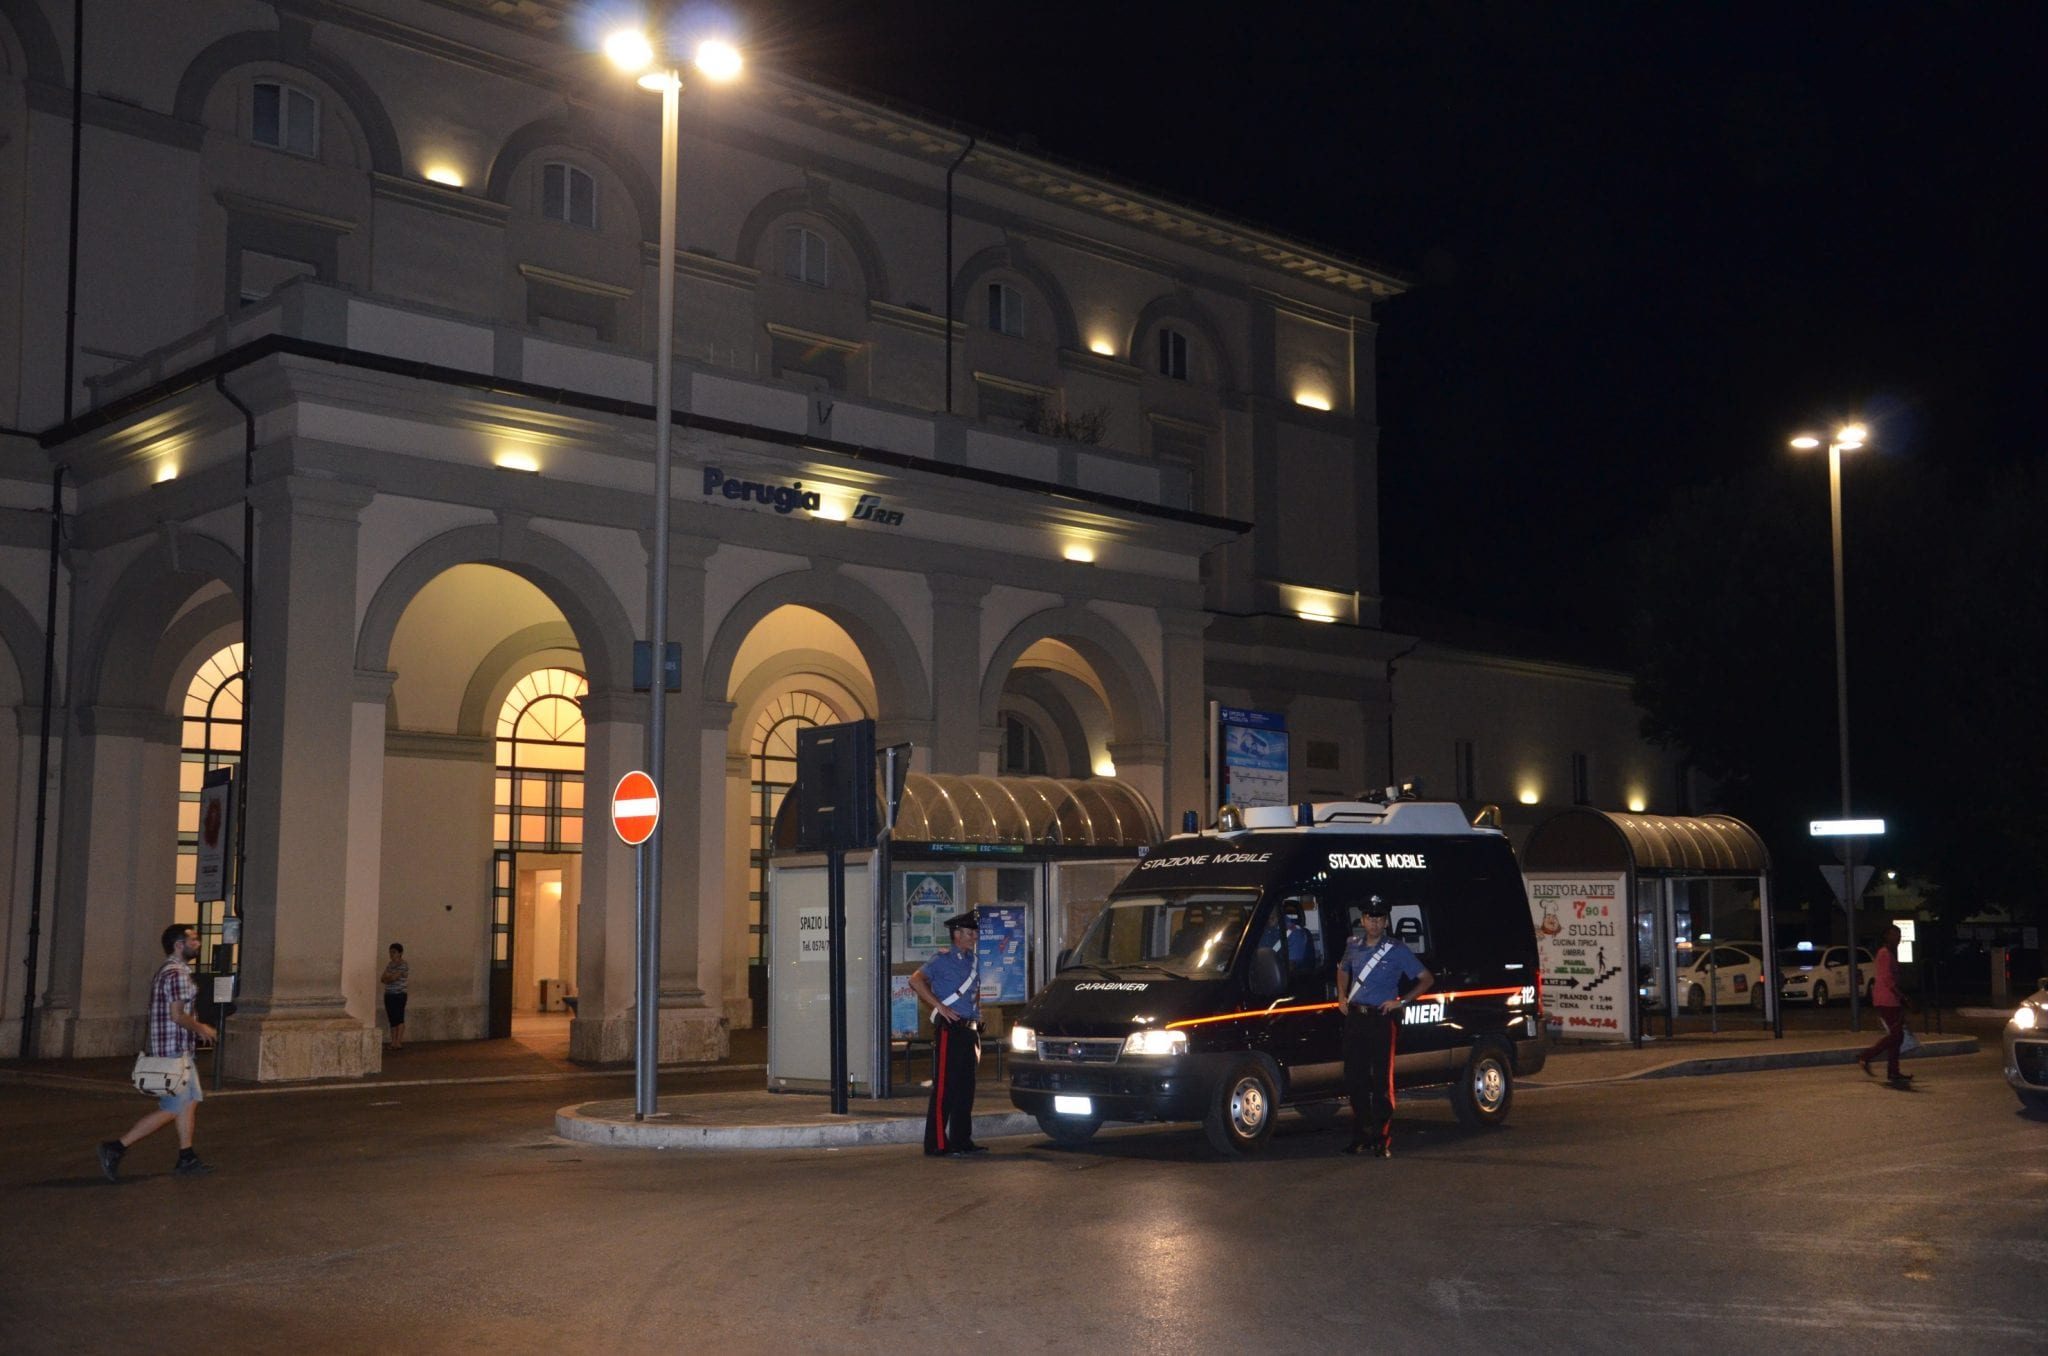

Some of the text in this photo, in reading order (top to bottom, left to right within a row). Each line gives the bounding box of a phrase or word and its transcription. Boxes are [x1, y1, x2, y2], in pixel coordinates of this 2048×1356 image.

[703, 466, 904, 526] Perugia RFI
[1141, 852, 1273, 870] STAZIONE MOBILE
[1328, 853, 1427, 869] STAZIONE MOBILE
[1533, 884, 1615, 896] RISTORANTE
[800, 916, 822, 930] SPAZIO
[1568, 921, 1615, 937] sushi
[1552, 939, 1598, 947] CUCINA TIPICA
[1074, 982, 1149, 992] CARABINIERI
[1521, 986, 1535, 1004] 112
[1559, 993, 1588, 1001] PRANZO
